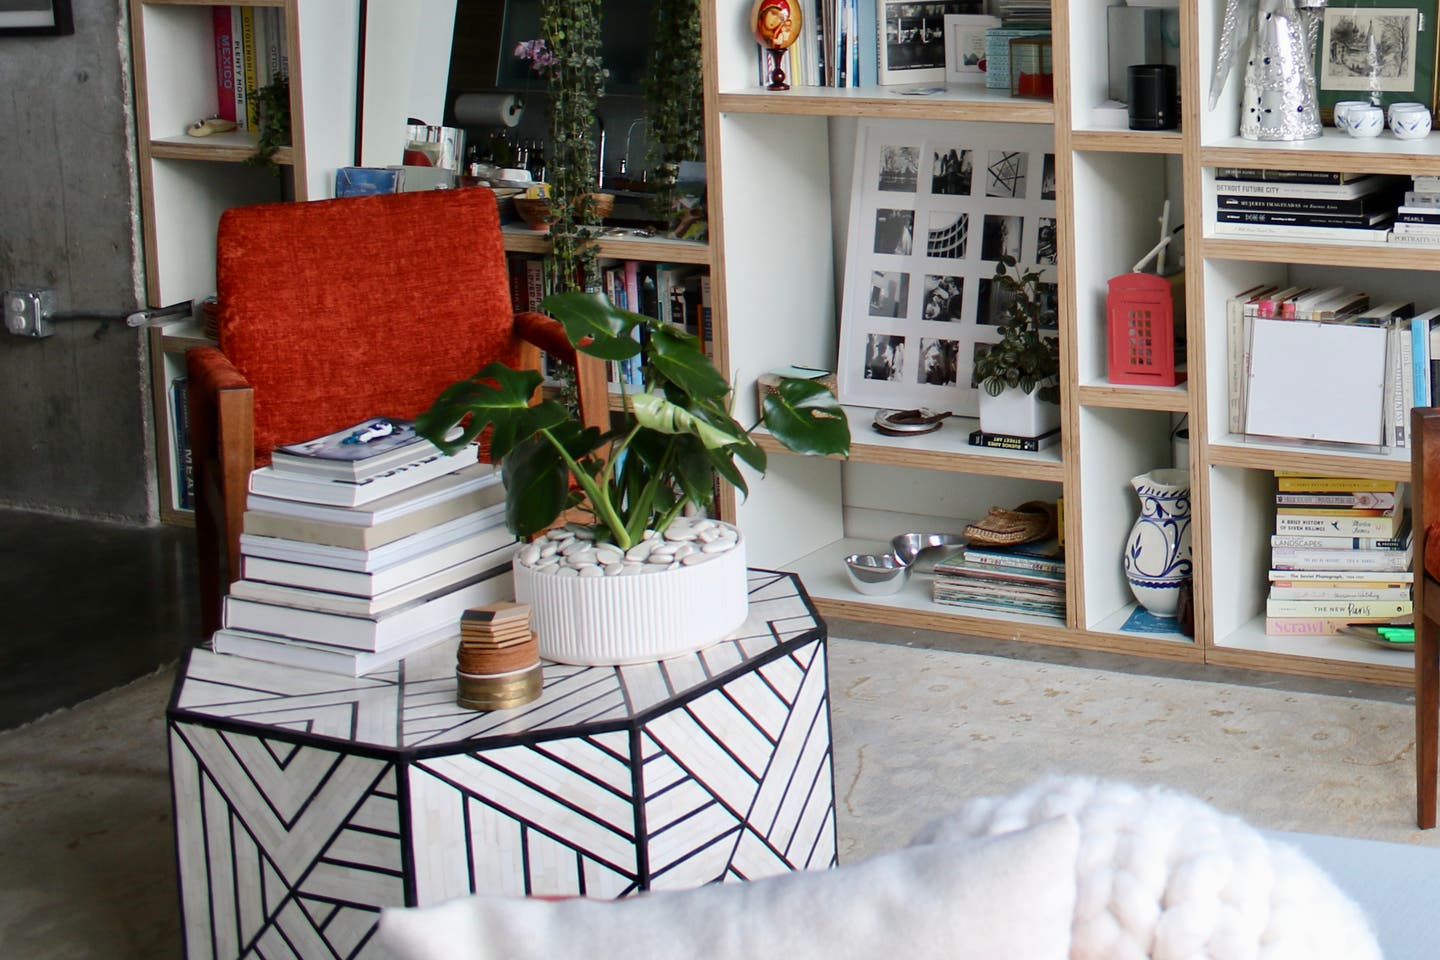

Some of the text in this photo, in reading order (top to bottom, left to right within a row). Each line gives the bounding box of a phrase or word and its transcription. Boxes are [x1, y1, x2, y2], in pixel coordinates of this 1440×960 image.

[244, 16, 252, 72] OTTOLENGHI
[222, 34, 232, 89] MEXICO
[1216, 184, 1279, 194] DETROIT FUTURE CITY
[987, 440, 1002, 448] AIRES
[1273, 539, 1323, 547] LANDSCAPES
[1347, 602, 1371, 616] Paris
[1274, 621, 1325, 633] Scrawl
